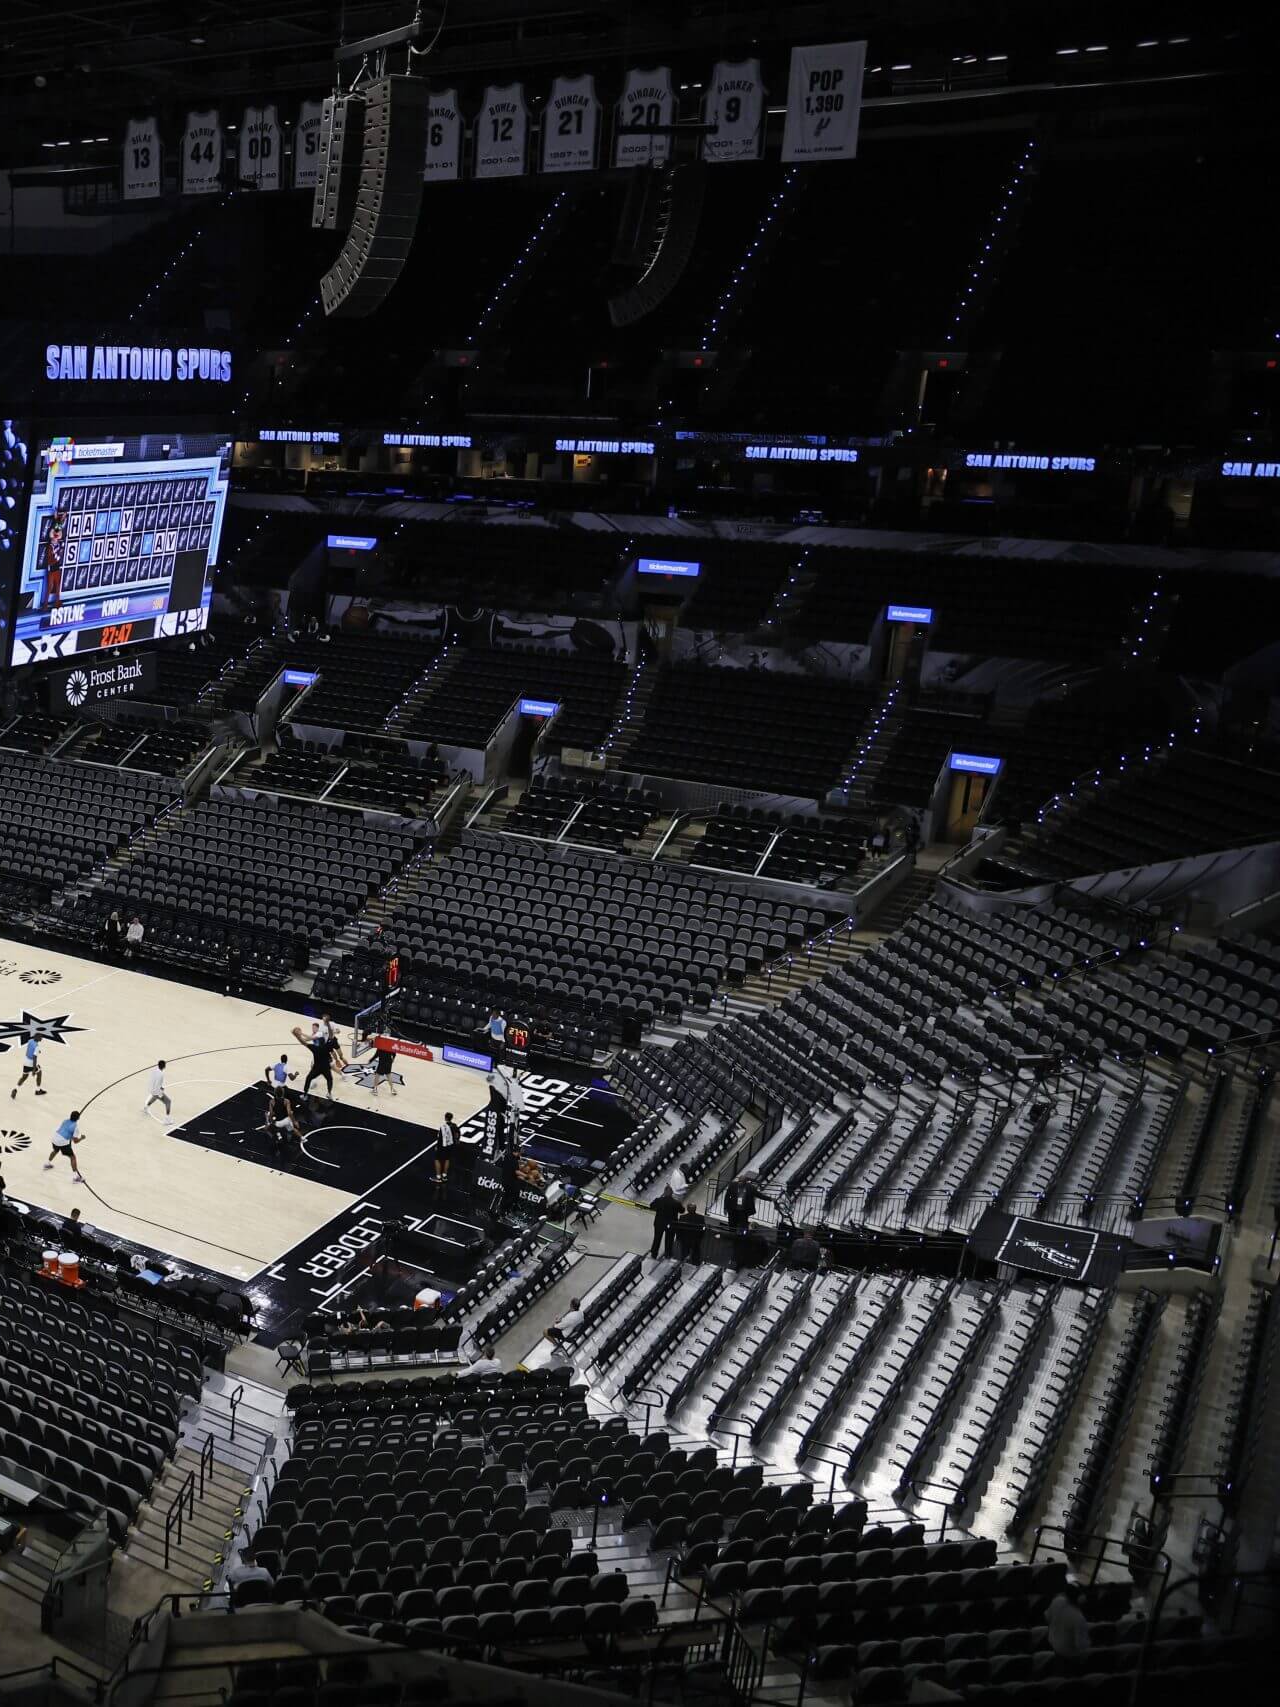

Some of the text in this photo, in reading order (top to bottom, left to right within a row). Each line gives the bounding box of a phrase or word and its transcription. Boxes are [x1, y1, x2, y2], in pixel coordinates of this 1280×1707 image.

[809, 69, 843, 92] POP
[631, 103, 660, 127] 20
[726, 97, 741, 123] 9
[492, 118, 513, 142] 12
[558, 110, 583, 136] 21
[431, 124, 442, 146] 6
[134, 148, 150, 169] 13
[191, 142, 214, 163] 44
[249, 137, 271, 159] 00
[46, 345, 232, 382] SAN ANTONIO SPURS
[555, 440, 654, 454] SAN ANTONIO SPURS
[746, 447, 857, 462] SAN ANTONIO SPURS
[966, 455, 1095, 471] SAN ANTONIO SPURS
[1222, 462, 1251, 476] SAN
[50, 604, 86, 626] RSTLNE
[101, 598, 129, 617] KMPU
[100, 624, 134, 647] 27:47
[90, 659, 143, 686] Frost Bank
[96, 683, 134, 698] CENTER
[447, 1050, 488, 1065] ticketmaster
[483, 1110, 498, 1155] bet365
[298, 1217, 384, 1278] LEDGER
